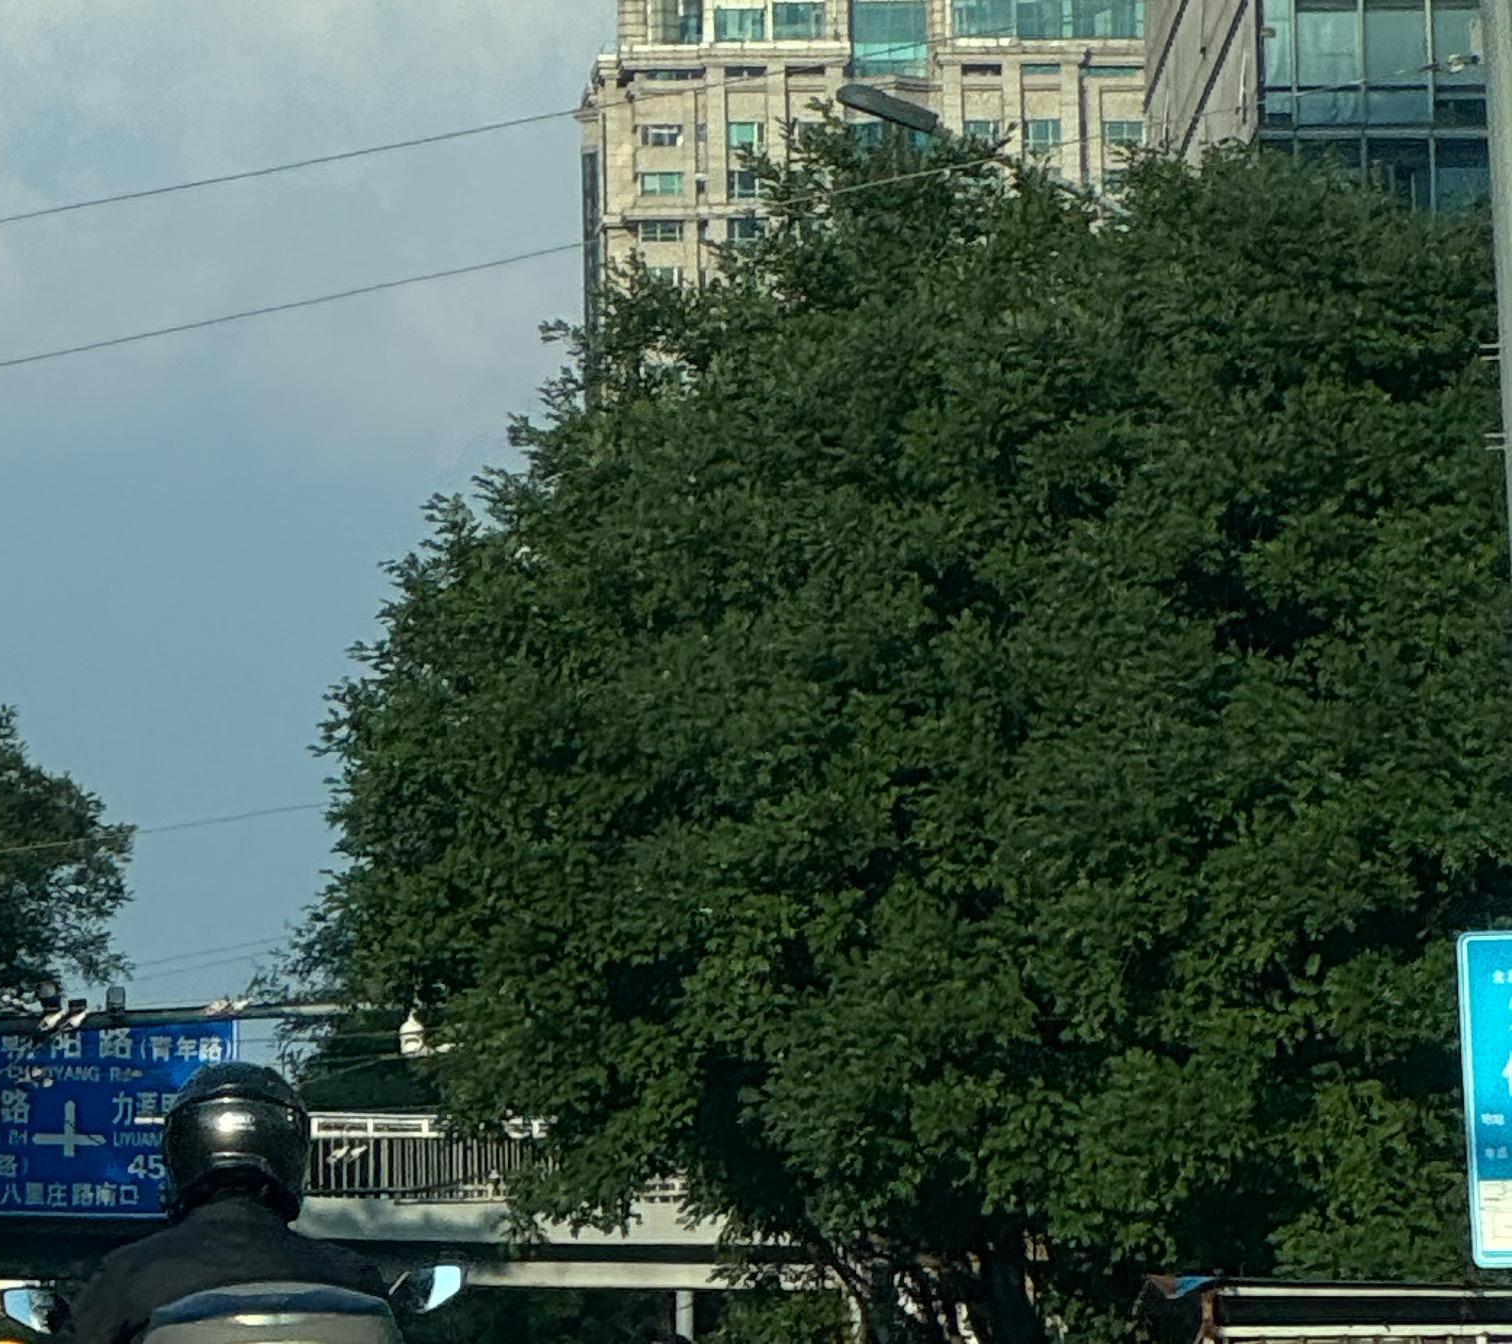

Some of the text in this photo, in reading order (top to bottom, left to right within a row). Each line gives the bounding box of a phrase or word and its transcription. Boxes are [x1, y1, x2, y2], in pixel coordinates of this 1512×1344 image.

[0, 1181, 140, 1208] 八里庄路南口
